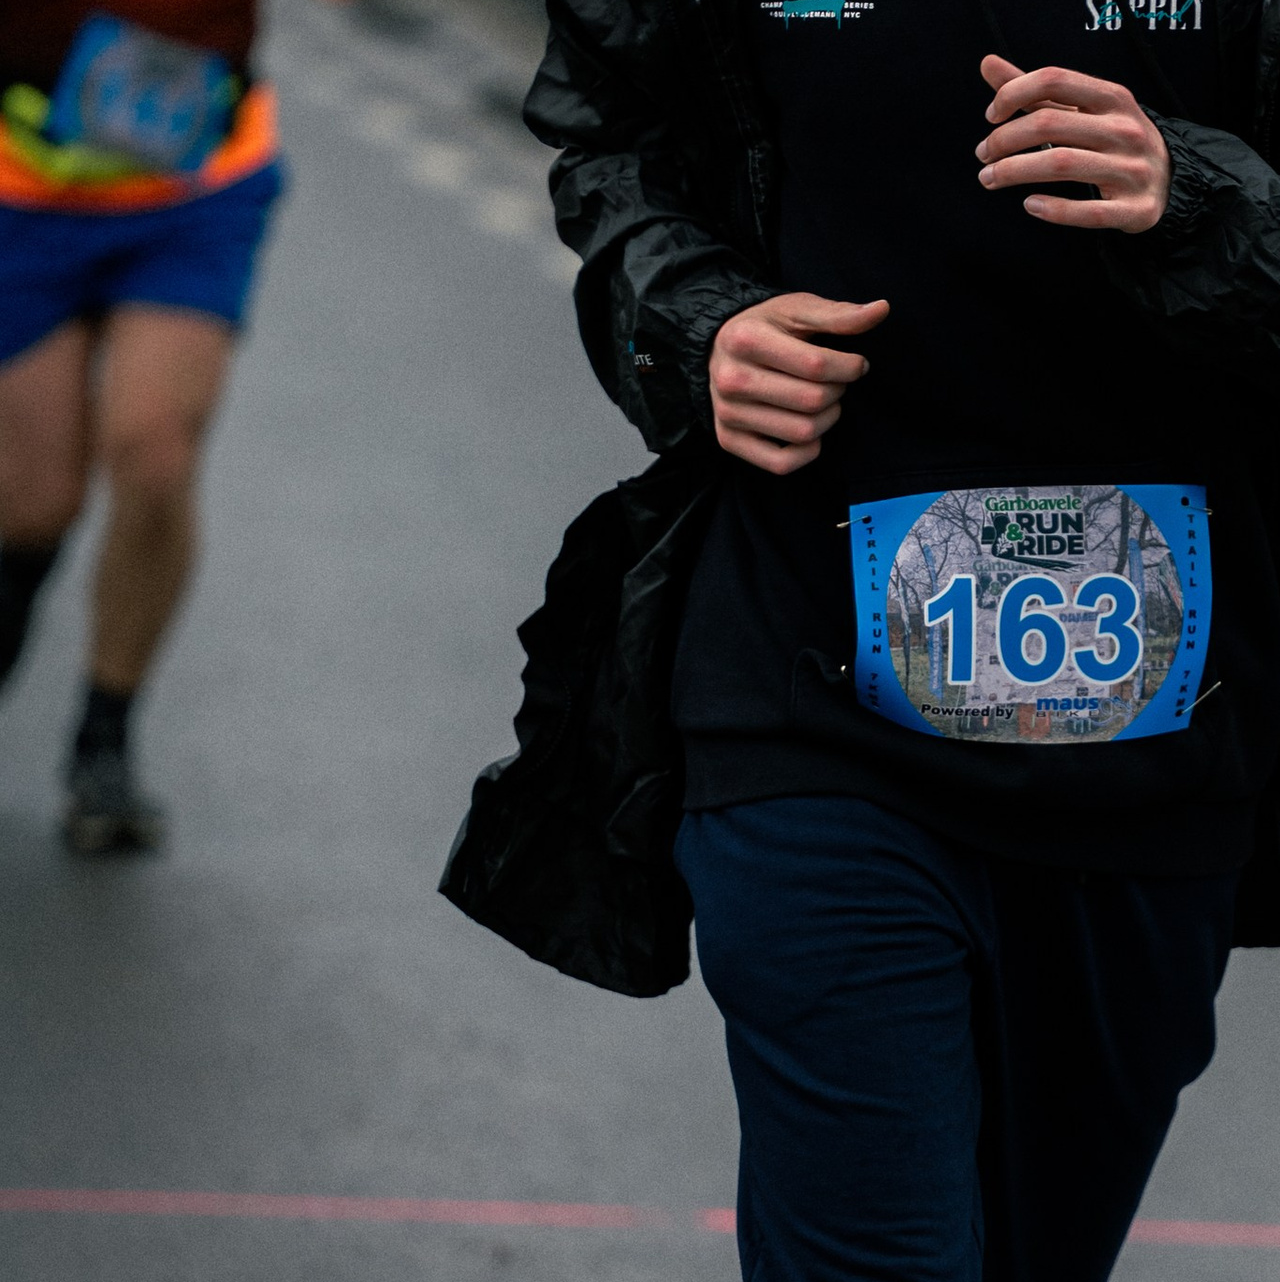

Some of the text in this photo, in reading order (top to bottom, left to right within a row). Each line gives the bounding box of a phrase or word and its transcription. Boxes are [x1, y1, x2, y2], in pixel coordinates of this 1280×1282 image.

[985, 495, 1081, 511] Gârboavele
[1006, 523, 1024, 541] &
[1016, 512, 1084, 533] RUN
[1017, 535, 1084, 555] RIDE
[1187, 514, 1197, 587] TRAIL
[866, 527, 880, 591] TRAIL
[872, 613, 882, 654] RUN
[925, 573, 1143, 685] 163
[1186, 610, 1197, 649] RUN
[921, 704, 1014, 719] Powered by
[1036, 697, 1099, 710] maus
